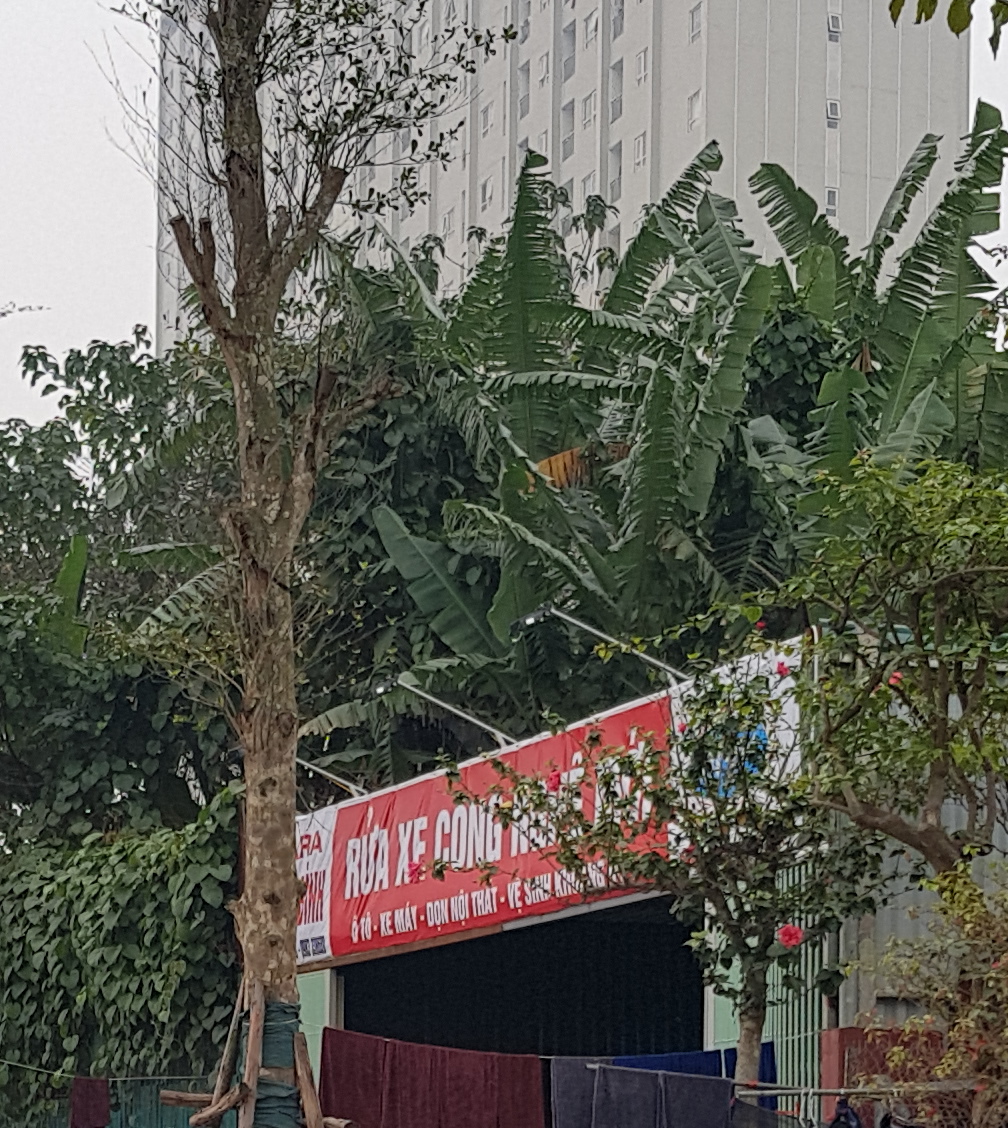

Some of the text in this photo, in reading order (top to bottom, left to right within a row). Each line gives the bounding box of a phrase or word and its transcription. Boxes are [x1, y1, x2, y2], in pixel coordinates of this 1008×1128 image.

[345, 805, 389, 900] RỬA
[394, 816, 428, 887] XE
[379, 911, 394, 938] XE
[394, 901, 418, 934] MÁY
[426, 898, 449, 931] DỌN
[450, 888, 470, 926] NỘI
